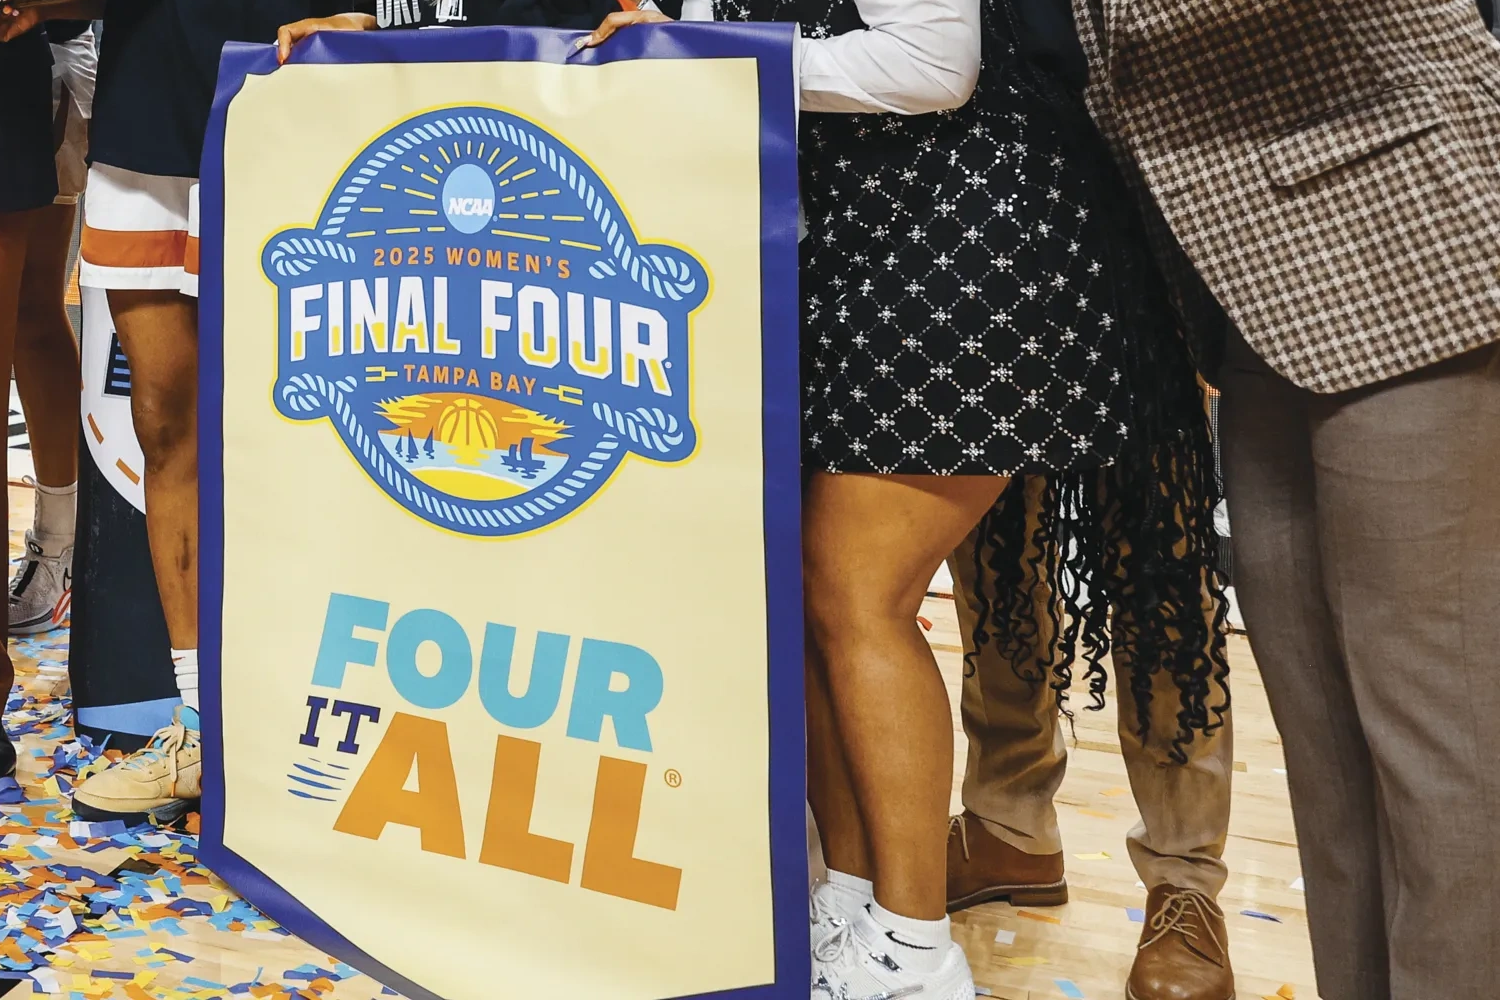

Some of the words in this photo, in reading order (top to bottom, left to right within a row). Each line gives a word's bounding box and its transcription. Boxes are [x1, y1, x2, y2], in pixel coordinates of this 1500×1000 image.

[448, 197, 494, 217] NCAA
[373, 247, 435, 267] 2025
[446, 248, 571, 279] WOMEN'S
[289, 276, 461, 362] FINAL
[480, 279, 673, 397] FOUR
[403, 364, 480, 388] TAMPA
[490, 372, 537, 397] BAY
[311, 592, 664, 753] FOUR
[298, 695, 382, 755] IT
[332, 711, 683, 912] ALL
